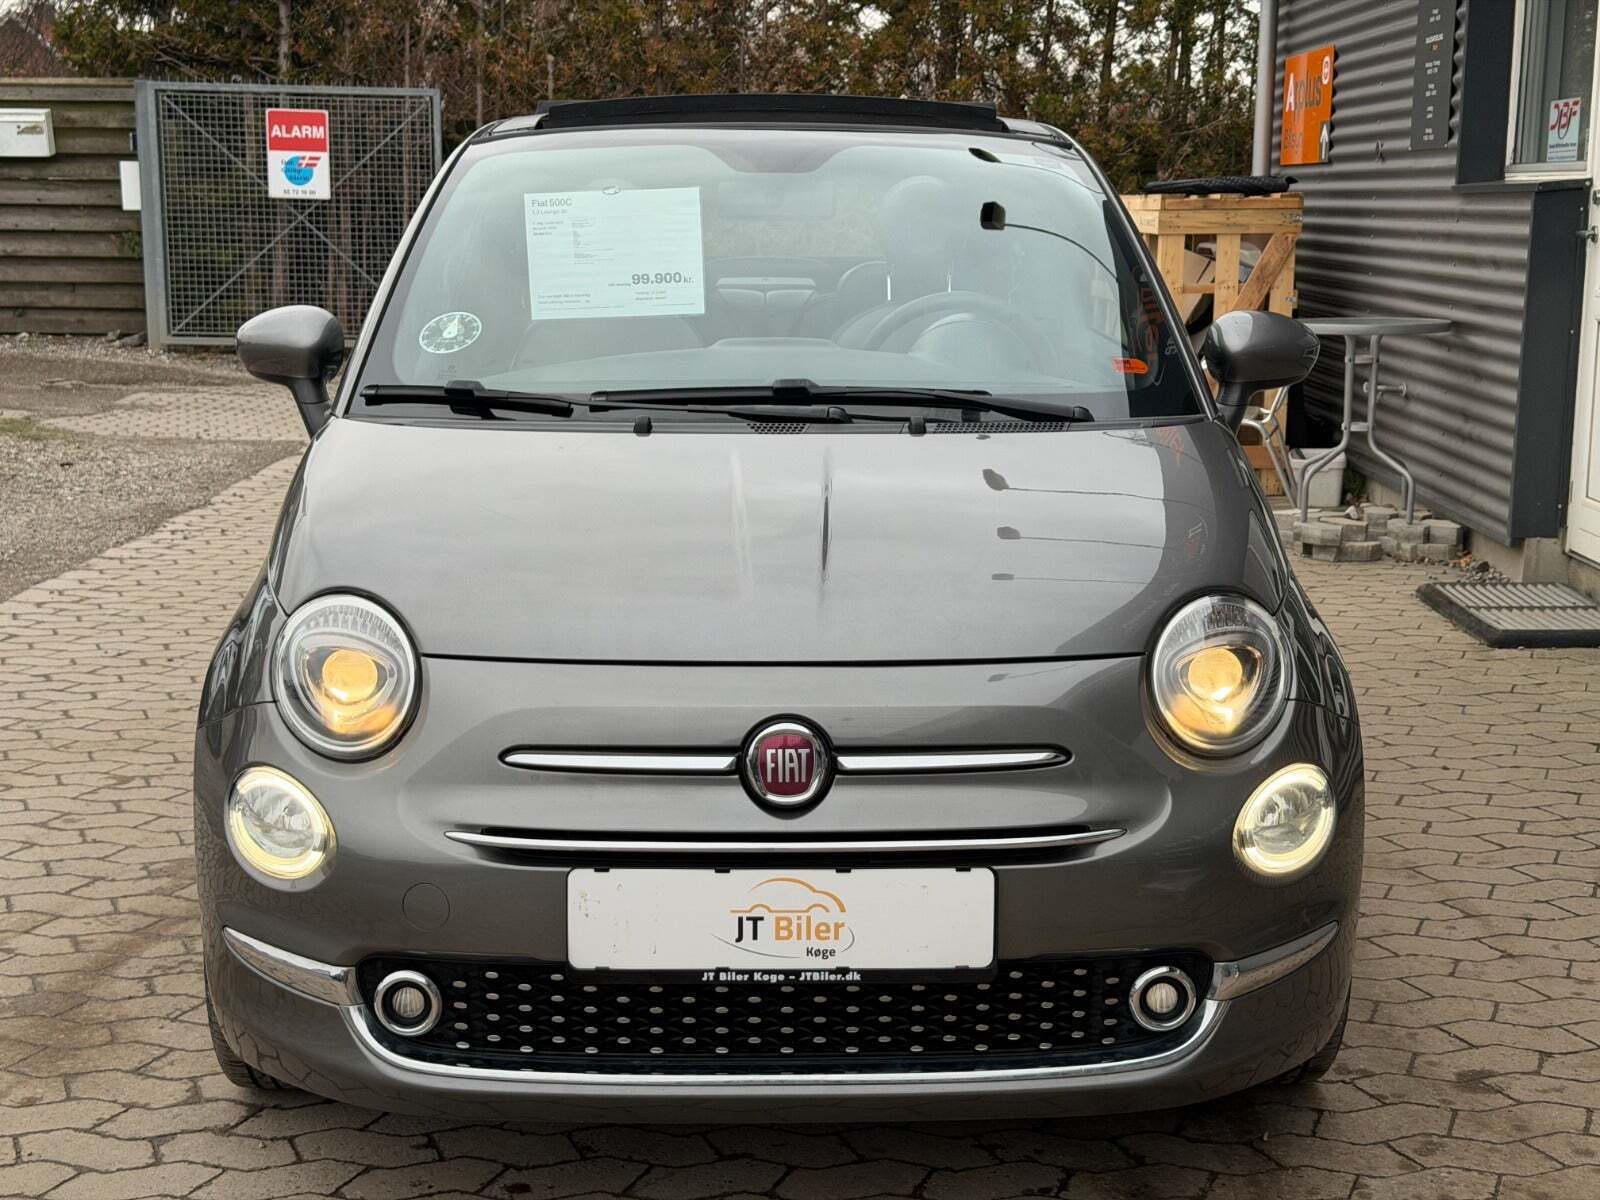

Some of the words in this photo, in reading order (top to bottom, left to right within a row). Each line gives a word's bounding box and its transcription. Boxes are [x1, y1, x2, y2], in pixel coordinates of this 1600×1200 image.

[271, 124, 324, 139] ALARM
[531, 199, 548, 207] Fiat
[549, 198, 572, 207] 500C
[631, 272, 682, 285] 99.900
[766, 748, 810, 783] FIAT
[735, 916, 764, 943] JT
[774, 915, 845, 941] Biler
[806, 947, 836, 960] Køge
[702, 972, 715, 981] JT
[719, 972, 749, 981] Biler
[799, 971, 861, 981] JTBiler.dk
